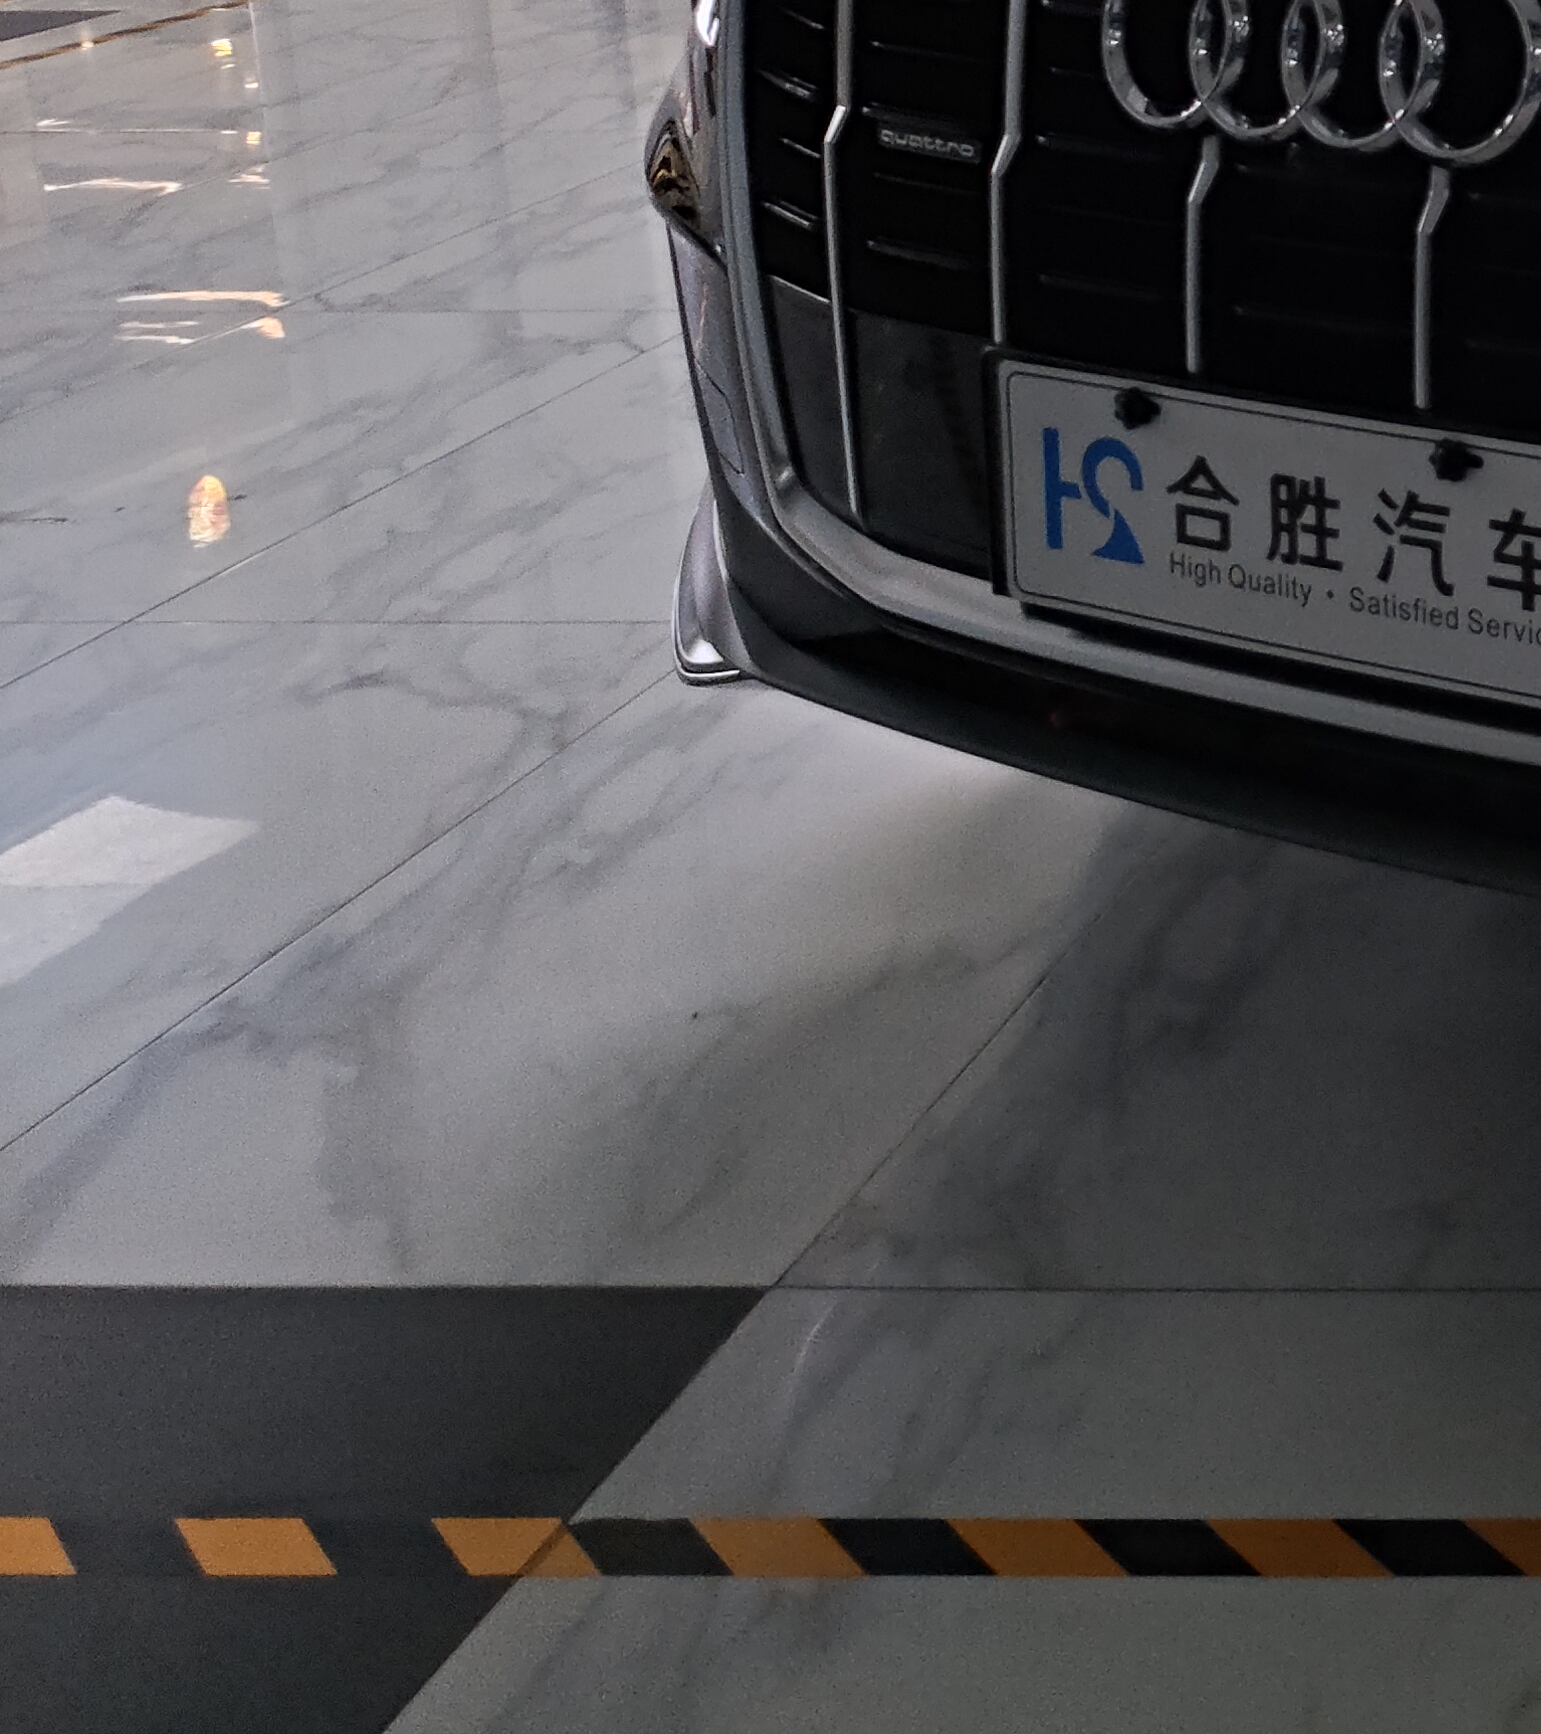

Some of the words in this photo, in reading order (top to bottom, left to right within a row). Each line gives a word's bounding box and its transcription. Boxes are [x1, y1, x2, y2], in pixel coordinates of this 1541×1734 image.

[1169, 550, 1222, 588] High
[1227, 563, 1313, 608] Quality
[1348, 586, 1460, 631] Satisfied
